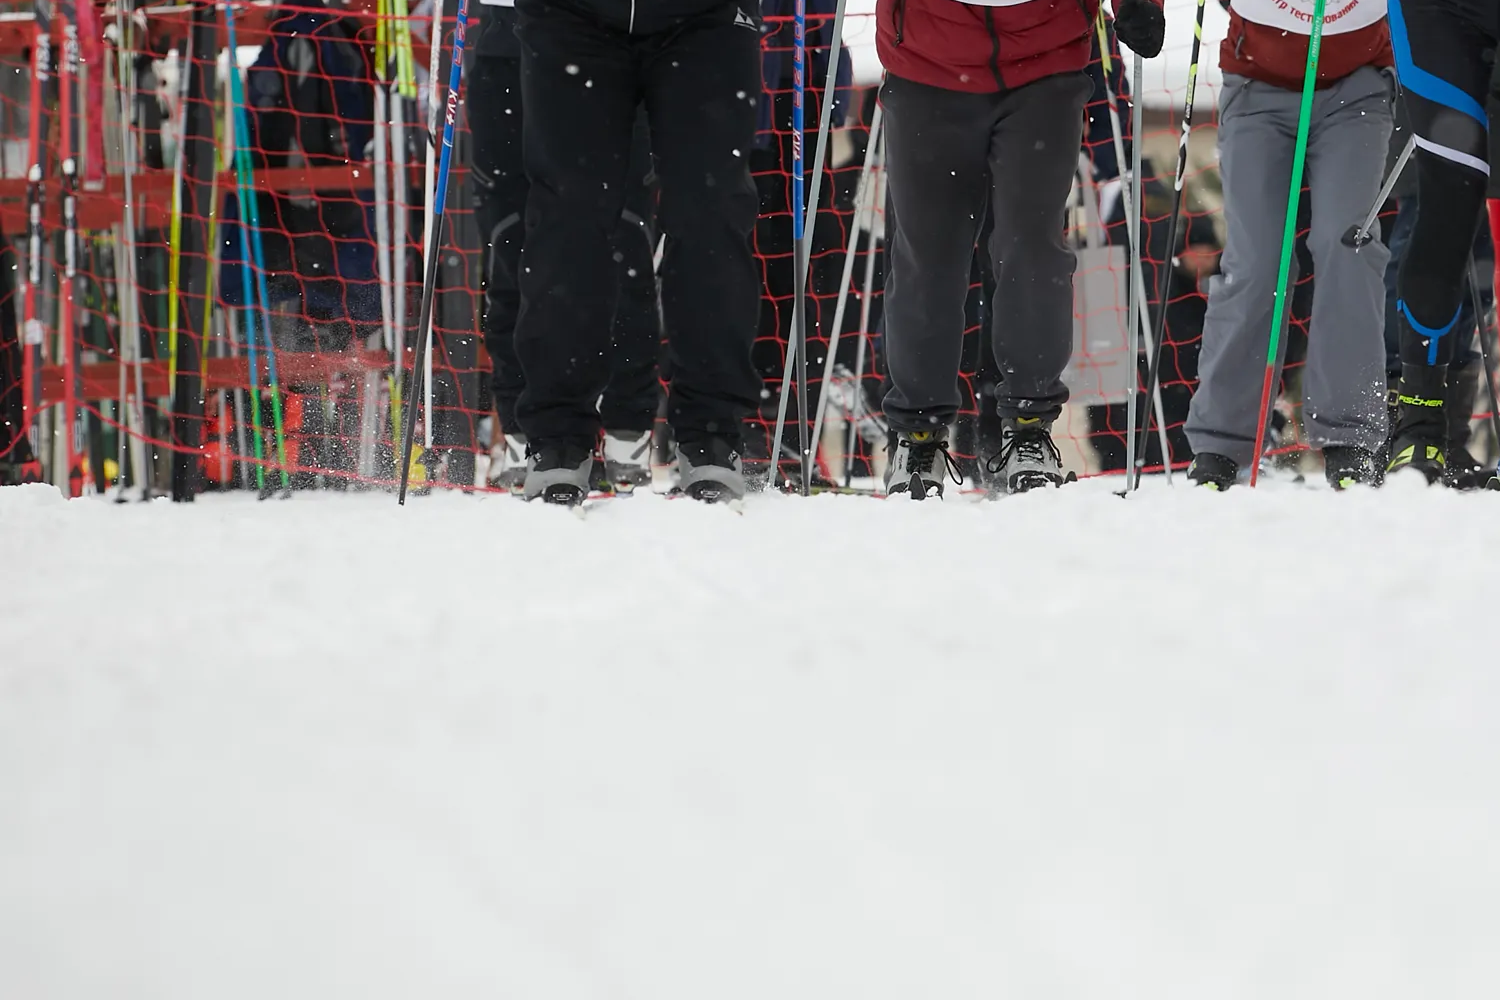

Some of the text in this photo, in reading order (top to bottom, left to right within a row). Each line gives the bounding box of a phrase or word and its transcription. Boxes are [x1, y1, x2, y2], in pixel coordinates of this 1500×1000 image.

[1290, 0, 1359, 25] тестования
[446, 87, 458, 125] KV+
[792, 127, 802, 160] KV+
[1399, 395, 1443, 407] FISCHER
